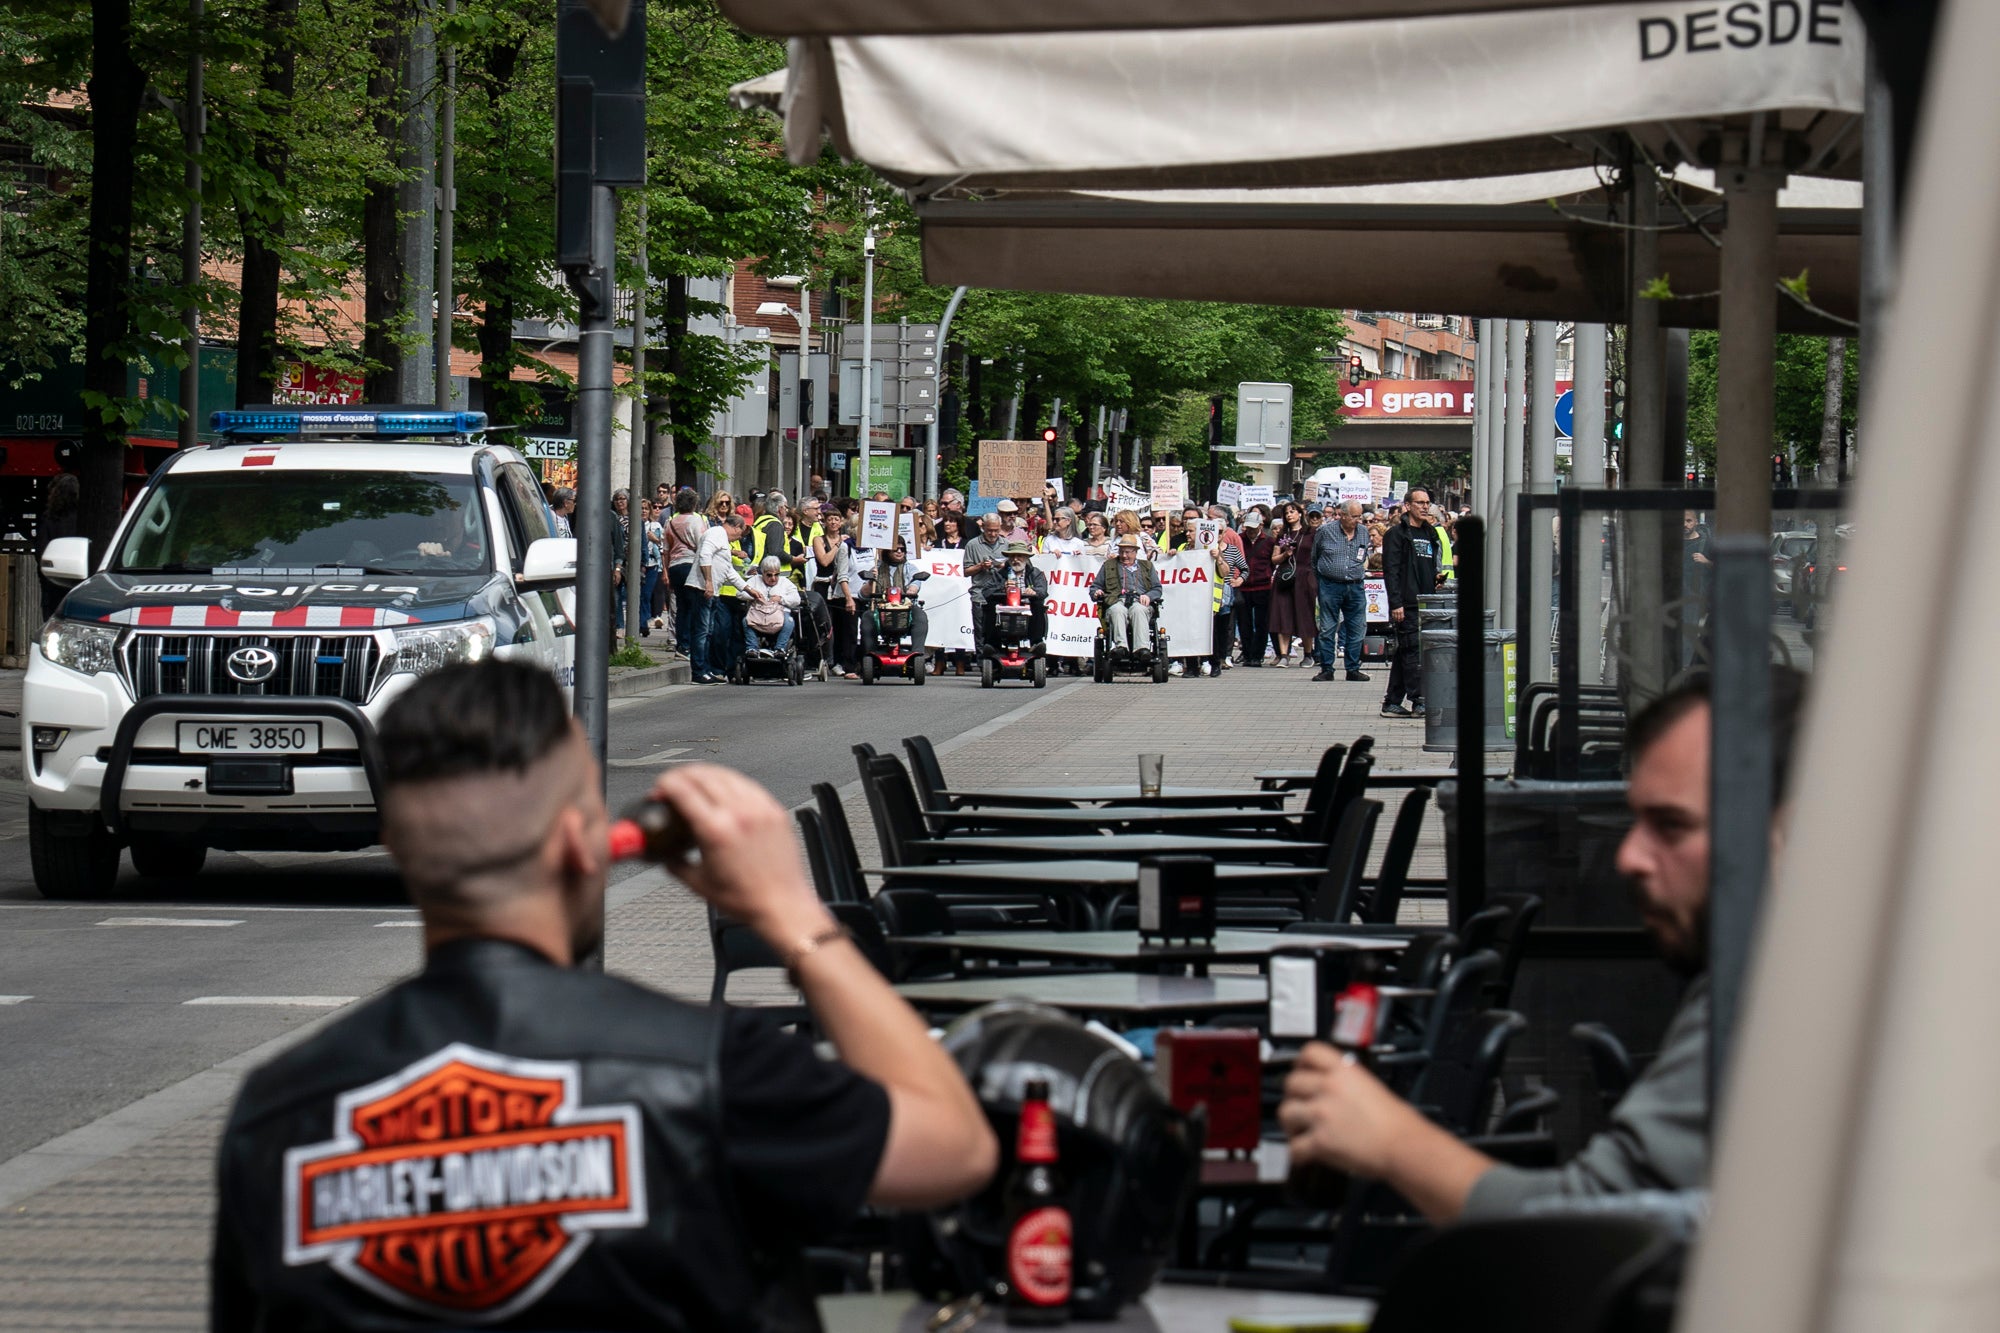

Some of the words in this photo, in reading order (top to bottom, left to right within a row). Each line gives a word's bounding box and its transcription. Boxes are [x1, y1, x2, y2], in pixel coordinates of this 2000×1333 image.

[1638, 0, 1845, 61] DESDE
[1344, 388, 1373, 408] el
[1381, 391, 1454, 414] gran
[16, 414, 64, 431] 020-0234
[303, 414, 332, 422] mossos
[333, 413, 376, 424] d'esquadra
[542, 415, 565, 426] ebab
[869, 463, 894, 477] ciutat
[867, 482, 889, 492] casa
[1118, 493, 1152, 506] PROFESS
[1046, 570, 1096, 588] NITA
[1157, 566, 1209, 585] LICA
[1050, 632, 1058, 640] la
[1061, 633, 1092, 643] Sanitat
[196, 727, 238, 749] CME
[249, 727, 306, 749] 3850
[310, 1134, 615, 1231] HARLEY-DAVIDSON
